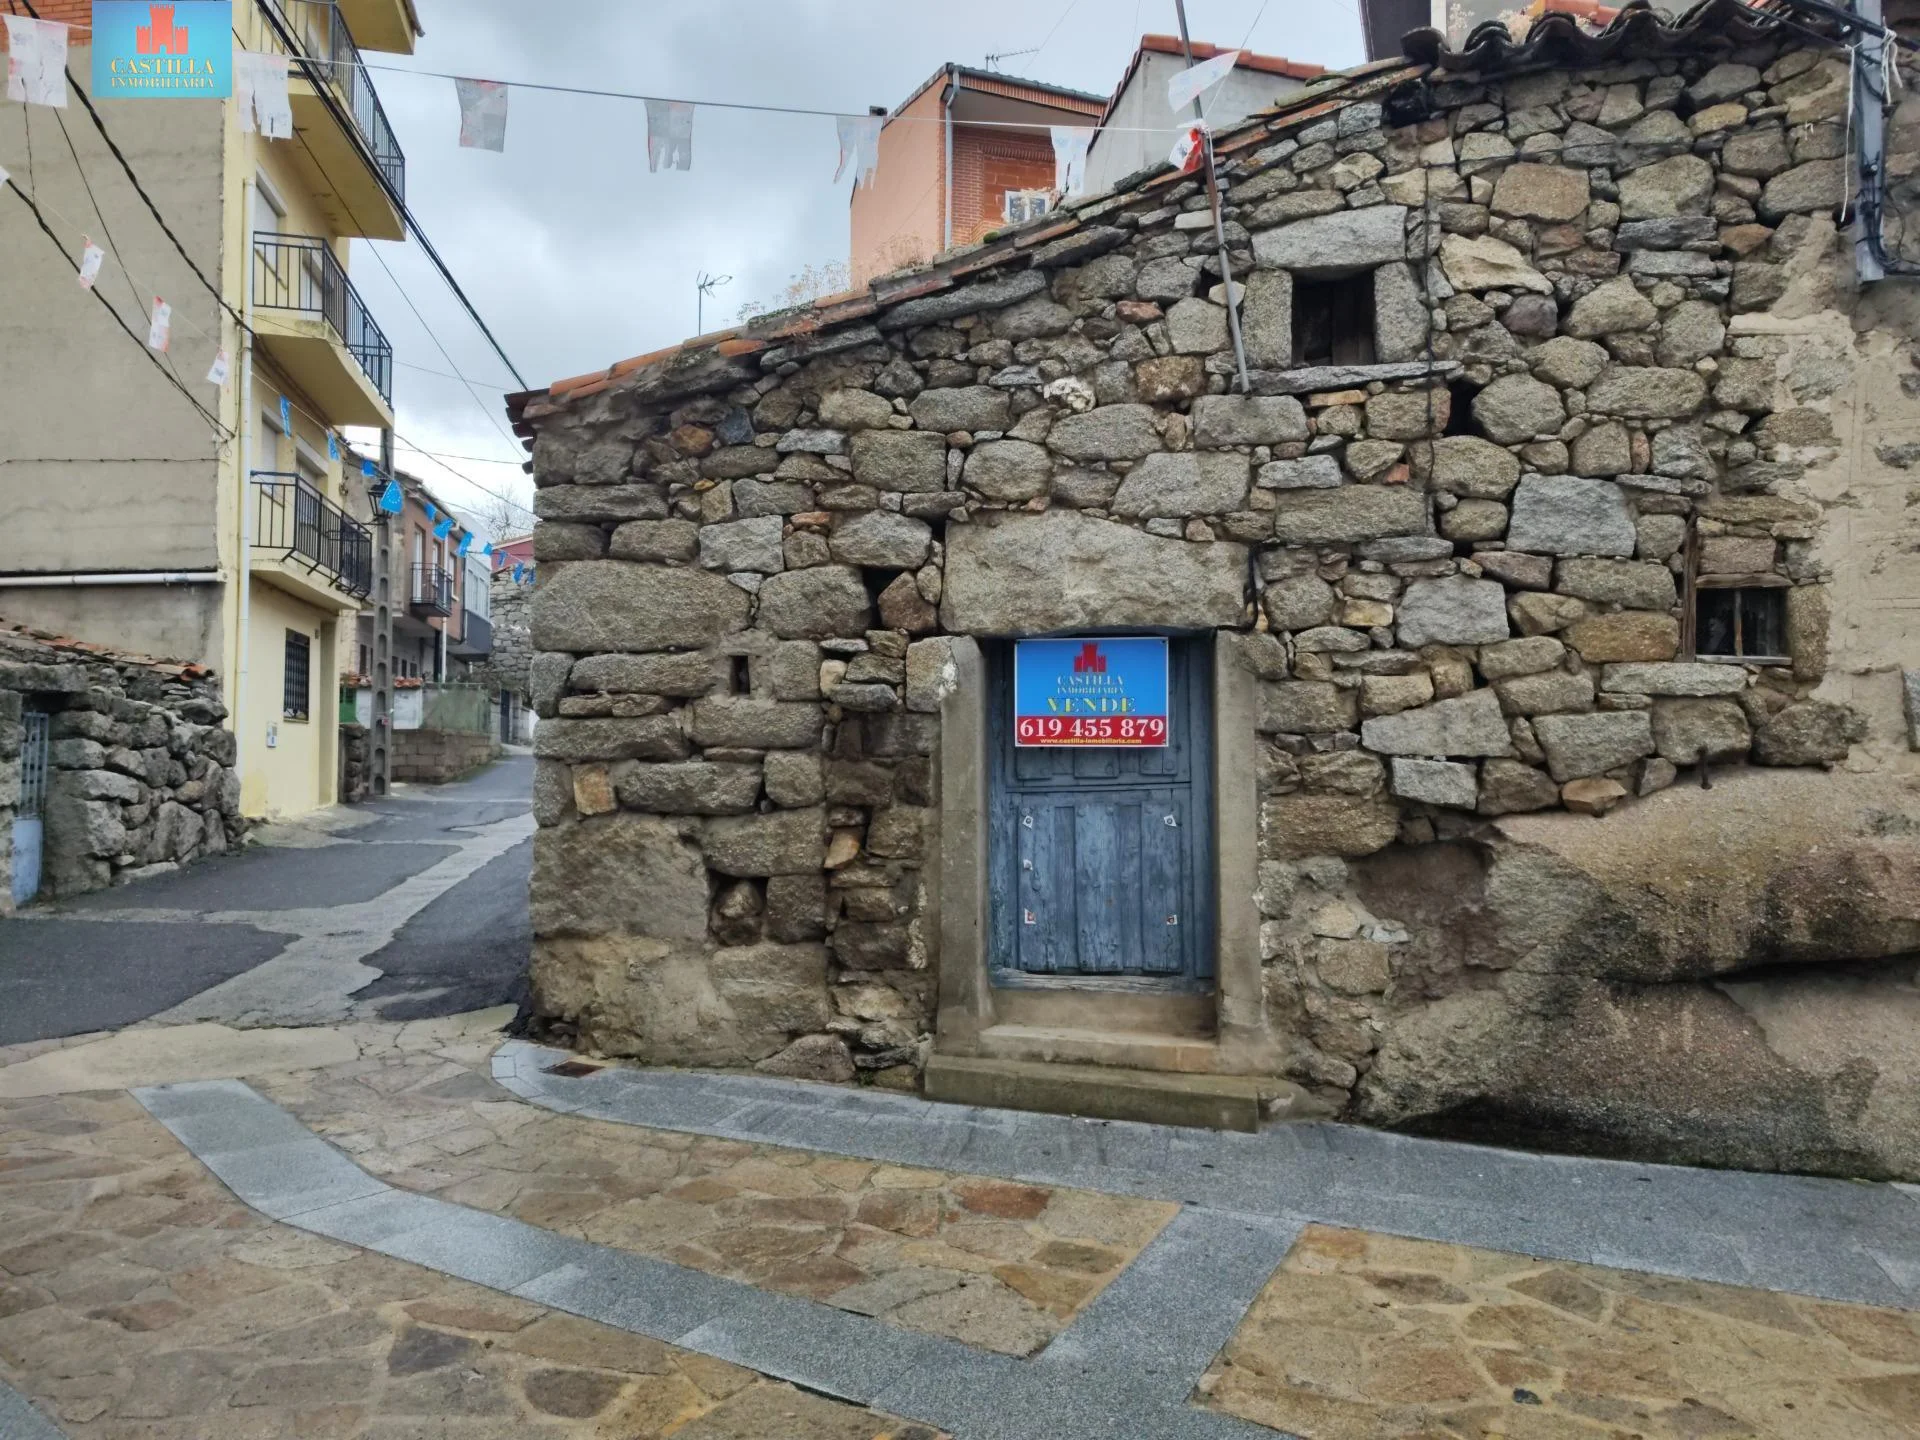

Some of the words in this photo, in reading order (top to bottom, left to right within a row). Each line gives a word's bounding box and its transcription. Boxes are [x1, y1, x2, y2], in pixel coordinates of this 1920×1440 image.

[1057, 675, 1124, 685] CASTILLA
[1047, 697, 1136, 713] VENDE
[1020, 718, 1062, 737] 619
[1069, 718, 1112, 737] 455
[1120, 718, 1164, 737] 879
